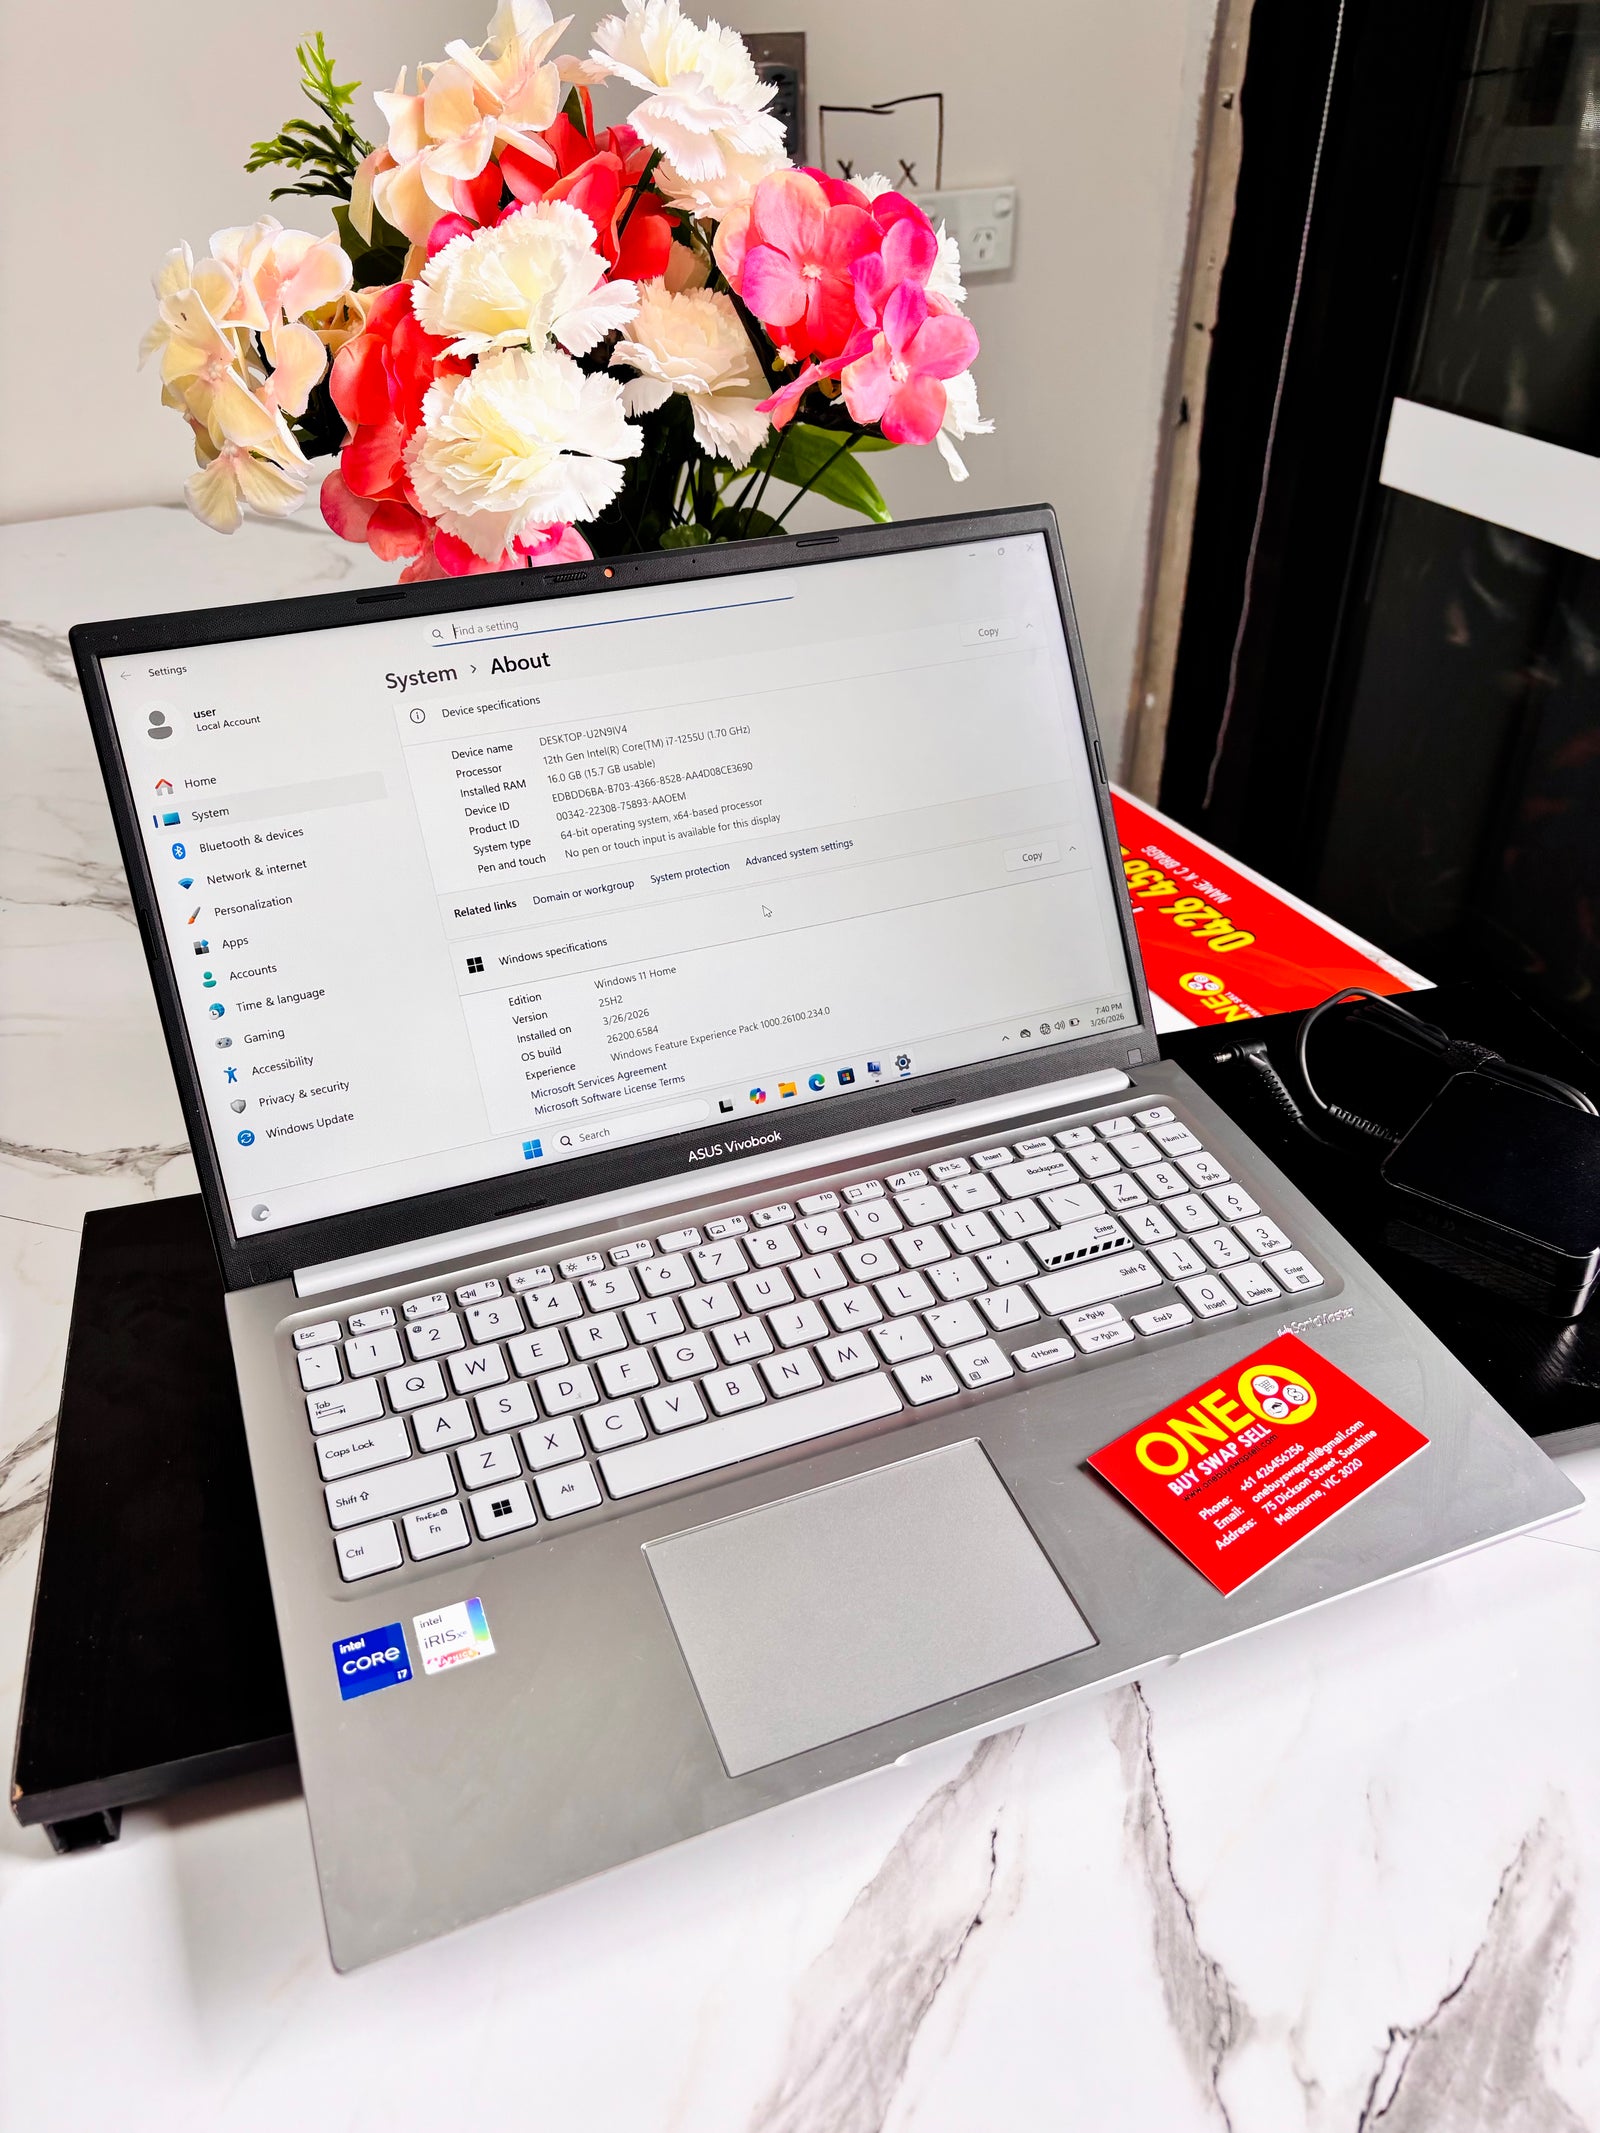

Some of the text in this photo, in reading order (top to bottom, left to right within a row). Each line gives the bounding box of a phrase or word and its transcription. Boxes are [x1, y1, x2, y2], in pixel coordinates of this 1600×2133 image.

[453, 624, 475, 639] Find
[485, 620, 519, 632] setting
[977, 627, 999, 638] Copy
[147, 666, 187, 677] Settings
[490, 652, 551, 675] About
[385, 667, 458, 693] System
[193, 708, 216, 719] user
[441, 696, 541, 718] Device specifications
[196, 715, 261, 732] Local Account
[451, 743, 513, 760] Device name
[542, 724, 751, 765] 12th Gen Intel(R) Core(TM) i7-1255U (1.70 GHz)
[455, 765, 502, 778] Processor
[546, 758, 656, 783] 16.0 GB (15.7 GB usable)
[184, 776, 217, 789] Home
[460, 778, 527, 798] Installed RAM
[191, 808, 230, 823] System
[464, 801, 510, 817] Device ID
[468, 819, 520, 835] Product ID
[560, 798, 762, 840] 64-bit operating system, x64-based processor
[199, 828, 304, 853] Bluetooth & devices
[472, 838, 531, 857] System type
[745, 839, 854, 866] Advanced system settings
[1021, 851, 1043, 862] Copy
[206, 859, 307, 885] Network & internet
[477, 853, 547, 873] Pen and touch
[649, 862, 731, 885] System protection
[532, 880, 635, 905] Domain or workgroup
[214, 895, 293, 917] Personalization
[453, 899, 517, 918] Related links
[1158, 896, 1256, 953] 0426
[222, 937, 249, 950] Apps
[497, 938, 608, 966] Windows specifications
[229, 964, 278, 981] Accounts
[593, 966, 677, 989] Windows 11 Home
[235, 988, 325, 1012] Time & language
[508, 993, 542, 1007] Edition
[598, 994, 624, 1008] 25H2
[1095, 1002, 1123, 1015] 7:40 PM
[511, 1011, 548, 1025] Version
[602, 1007, 650, 1026] 3/26/2026
[1090, 1012, 1125, 1027] 3/26/2026
[243, 1029, 286, 1044] Gaming
[516, 1025, 572, 1044] Installed on
[606, 1024, 659, 1044] 26200.6584
[609, 1005, 831, 1062] Windows Feature Experience Pack 1000.26100.234.0
[520, 1044, 562, 1062] OS build
[251, 1055, 314, 1076] Accessibility
[524, 1063, 576, 1081] Experience
[530, 1062, 668, 1099] Microsoft Services Agreement
[258, 1080, 350, 1107] Privacy & security
[534, 1075, 686, 1115] Microsoft Software License Terms
[265, 1113, 355, 1139] Windows Update
[578, 1127, 611, 1143] Search
[688, 1130, 782, 1163] ASUS Vivobook
[1022, 1141, 1047, 1152] Delete
[982, 1152, 1002, 1162] Insert
[1026, 1161, 1065, 1177] Backspace
[1094, 1223, 1115, 1234] Enter
[1119, 1265, 1138, 1277] Shift
[299, 1330, 316, 1340] Esc
[1036, 1346, 1059, 1359] Home
[314, 1399, 331, 1411] Tab
[325, 1438, 375, 1461] Caps Lock
[1168, 1423, 1272, 1496] BUY SWAP SELL
[1183, 1434, 1278, 1501] www.onebuyswapsell.com
[1198, 1442, 1305, 1520] Phone: +61 426456256
[1213, 1420, 1365, 1530] Email: onebuyswapsell@gmail.com
[560, 1482, 576, 1495] Alt
[1215, 1429, 1378, 1551] Address: 75 Dickson Street, Sunshine
[1273, 1457, 1363, 1526] Melbourne, VIC 3020
[335, 1493, 358, 1509] Shift
[429, 1523, 442, 1535] Fn
[345, 1545, 365, 1560] Ctrl
[420, 1615, 442, 1629] intel
[339, 1637, 366, 1655] intel
[397, 1668, 408, 1680] i7
